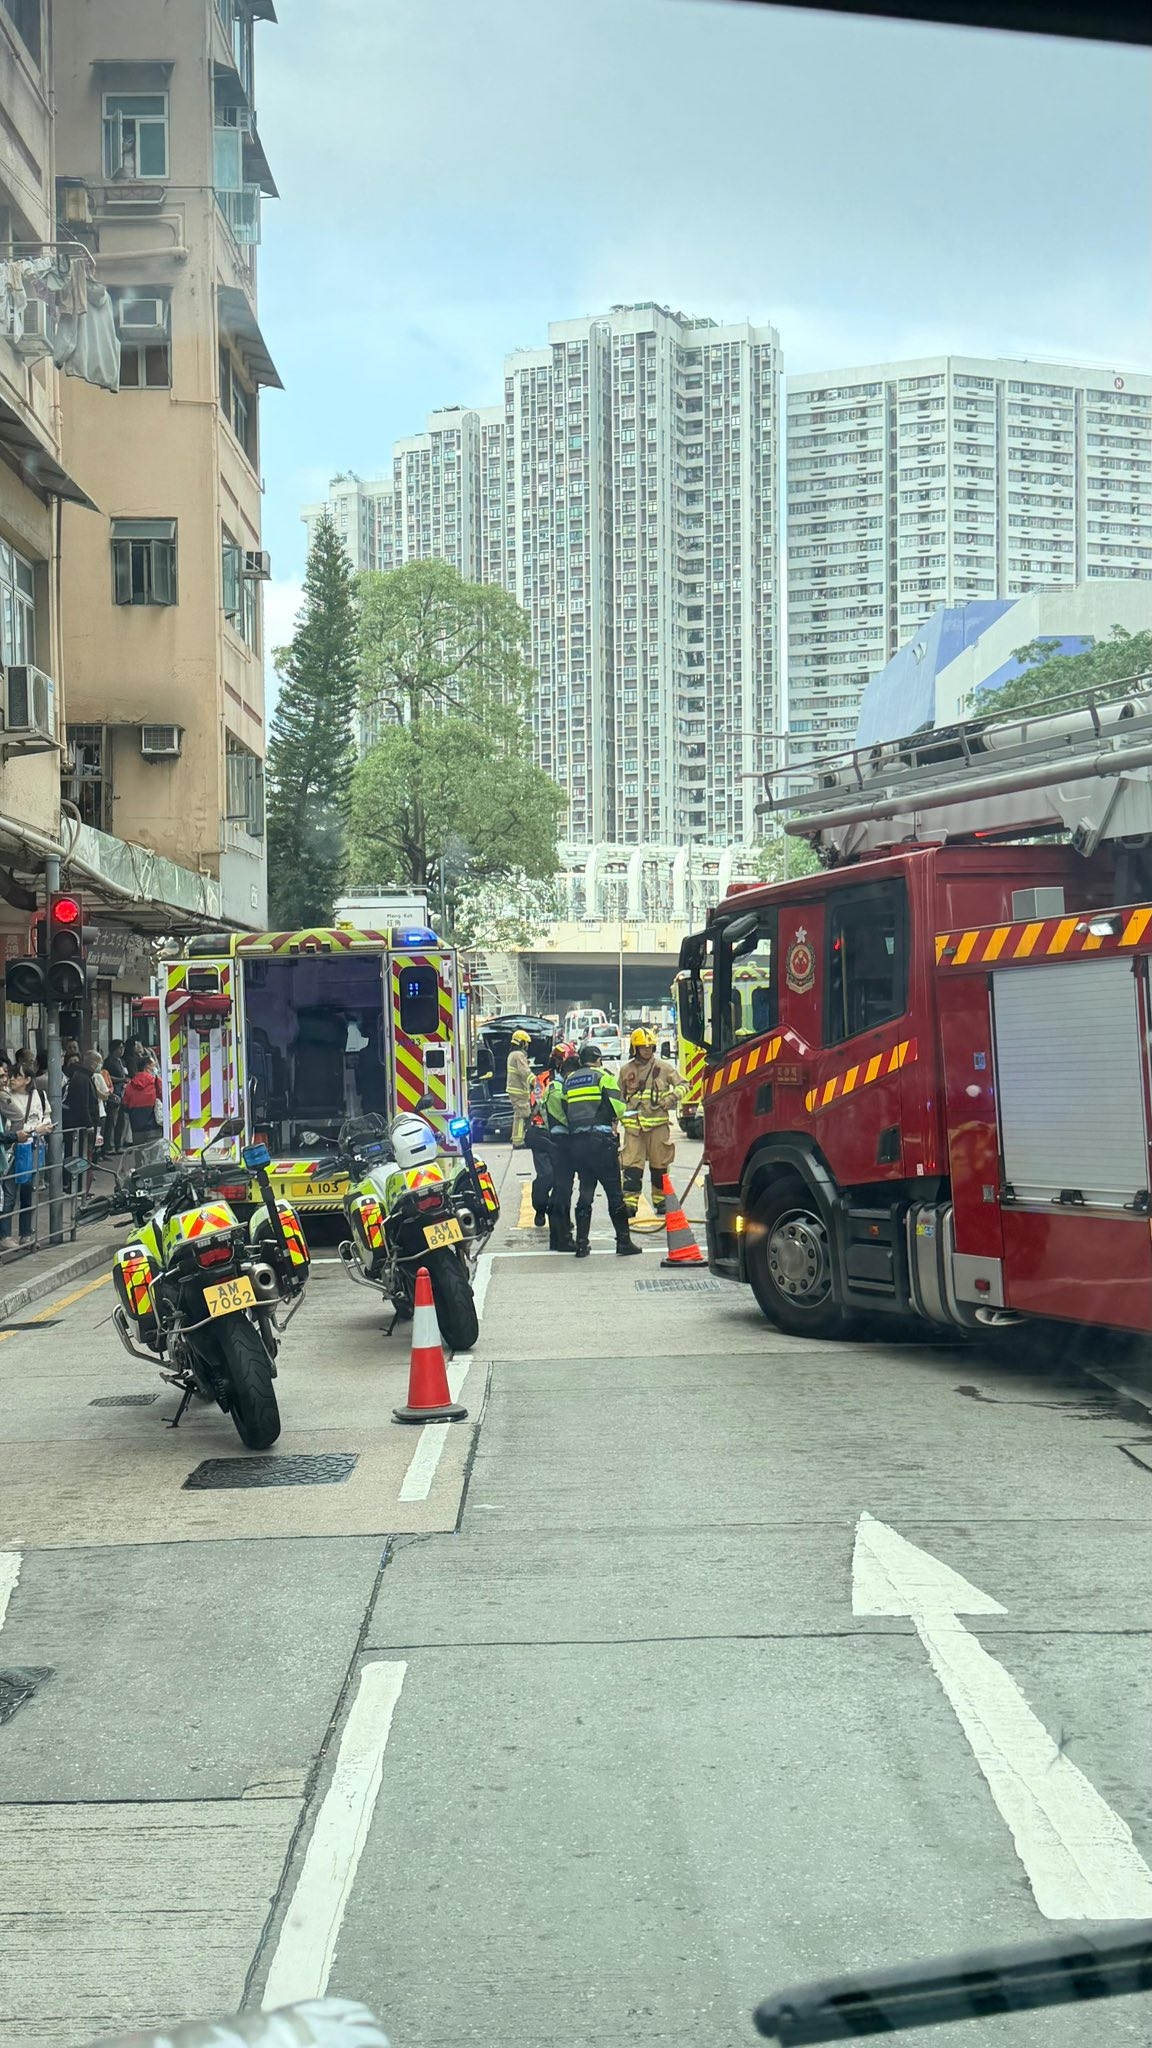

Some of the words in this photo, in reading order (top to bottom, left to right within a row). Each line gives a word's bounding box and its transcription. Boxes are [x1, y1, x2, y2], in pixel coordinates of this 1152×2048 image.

[305, 1184, 313, 1194] A
[318, 1182, 339, 1193] 103
[434, 1222, 450, 1235] AM
[430, 1229, 459, 1245] 8941
[217, 1281, 239, 1299] AM
[209, 1290, 254, 1314] 7062
